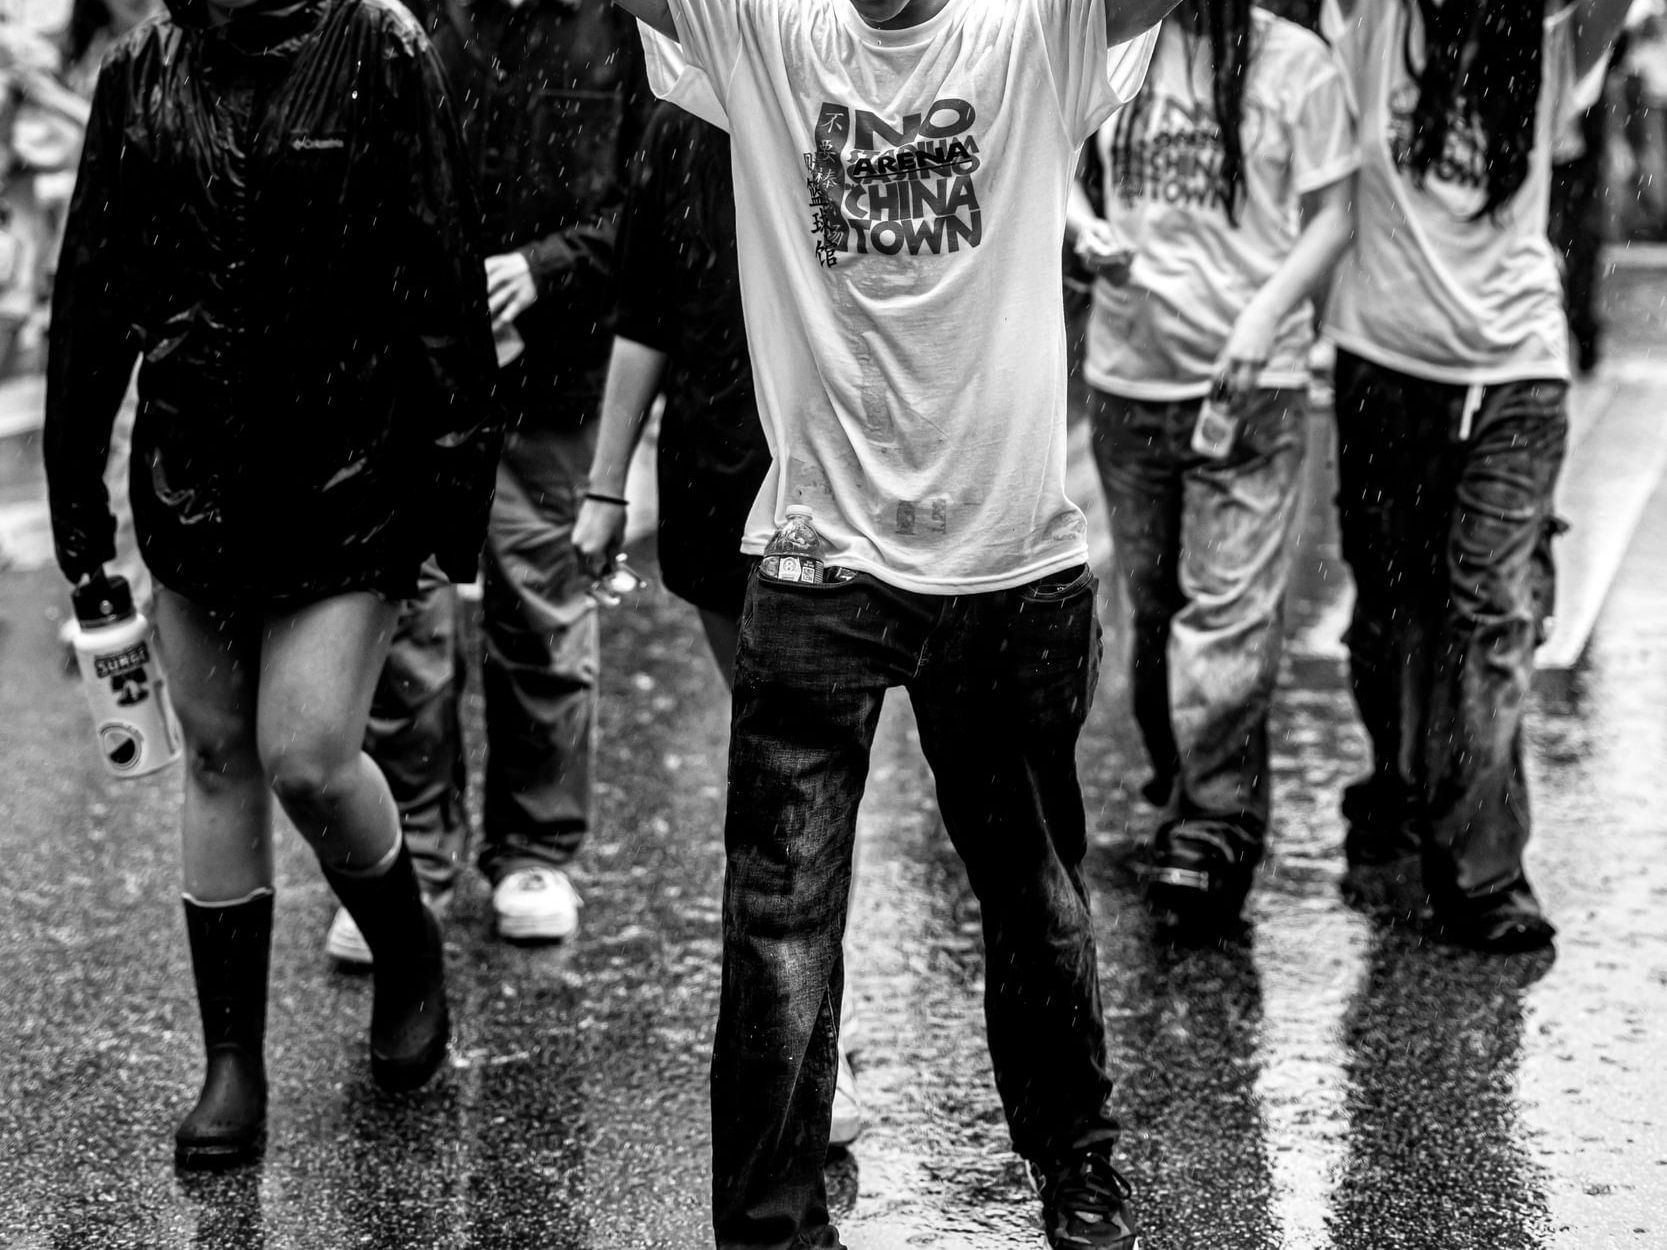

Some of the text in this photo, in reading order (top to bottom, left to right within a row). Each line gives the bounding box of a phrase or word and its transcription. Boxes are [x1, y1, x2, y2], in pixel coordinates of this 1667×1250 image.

[854, 98, 977, 151] NO
[853, 141, 973, 176] ARENA
[844, 175, 980, 221] CHINA
[848, 209, 982, 256] TOWN
